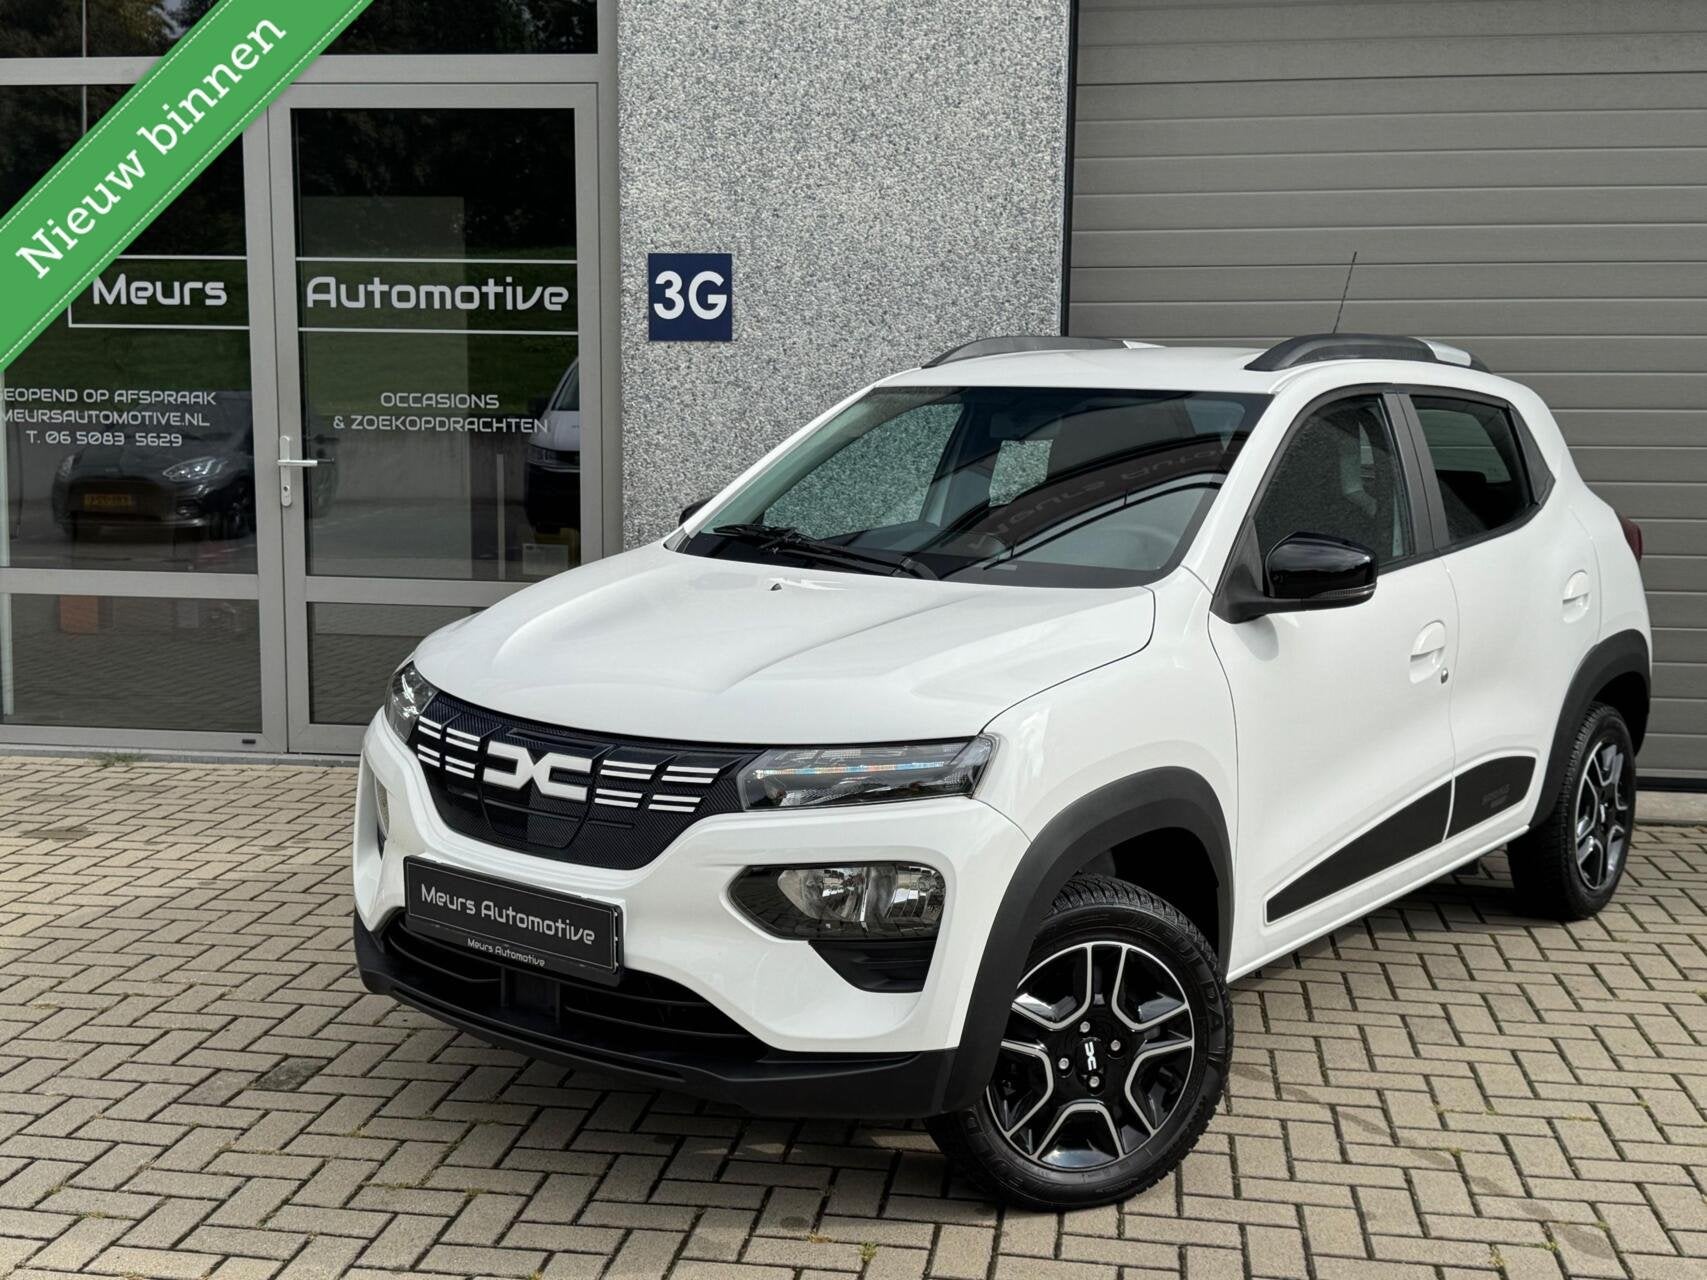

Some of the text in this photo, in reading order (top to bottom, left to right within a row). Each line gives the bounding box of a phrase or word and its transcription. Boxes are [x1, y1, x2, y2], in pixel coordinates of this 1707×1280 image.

[93, 273, 569, 312] Meurs Automotive
[653, 270, 728, 320] 3G
[83, 389, 109, 403] OP
[114, 390, 216, 405] AFSPRAAK
[380, 392, 500, 409] OCCASIONS
[333, 416, 548, 433] & ZOEKOPDRACHTEN
[26, 430, 182, 447] T. 06 5083 5629
[421, 883, 596, 945] Meurs Automotive
[467, 937, 546, 967] Meurs Automotive
